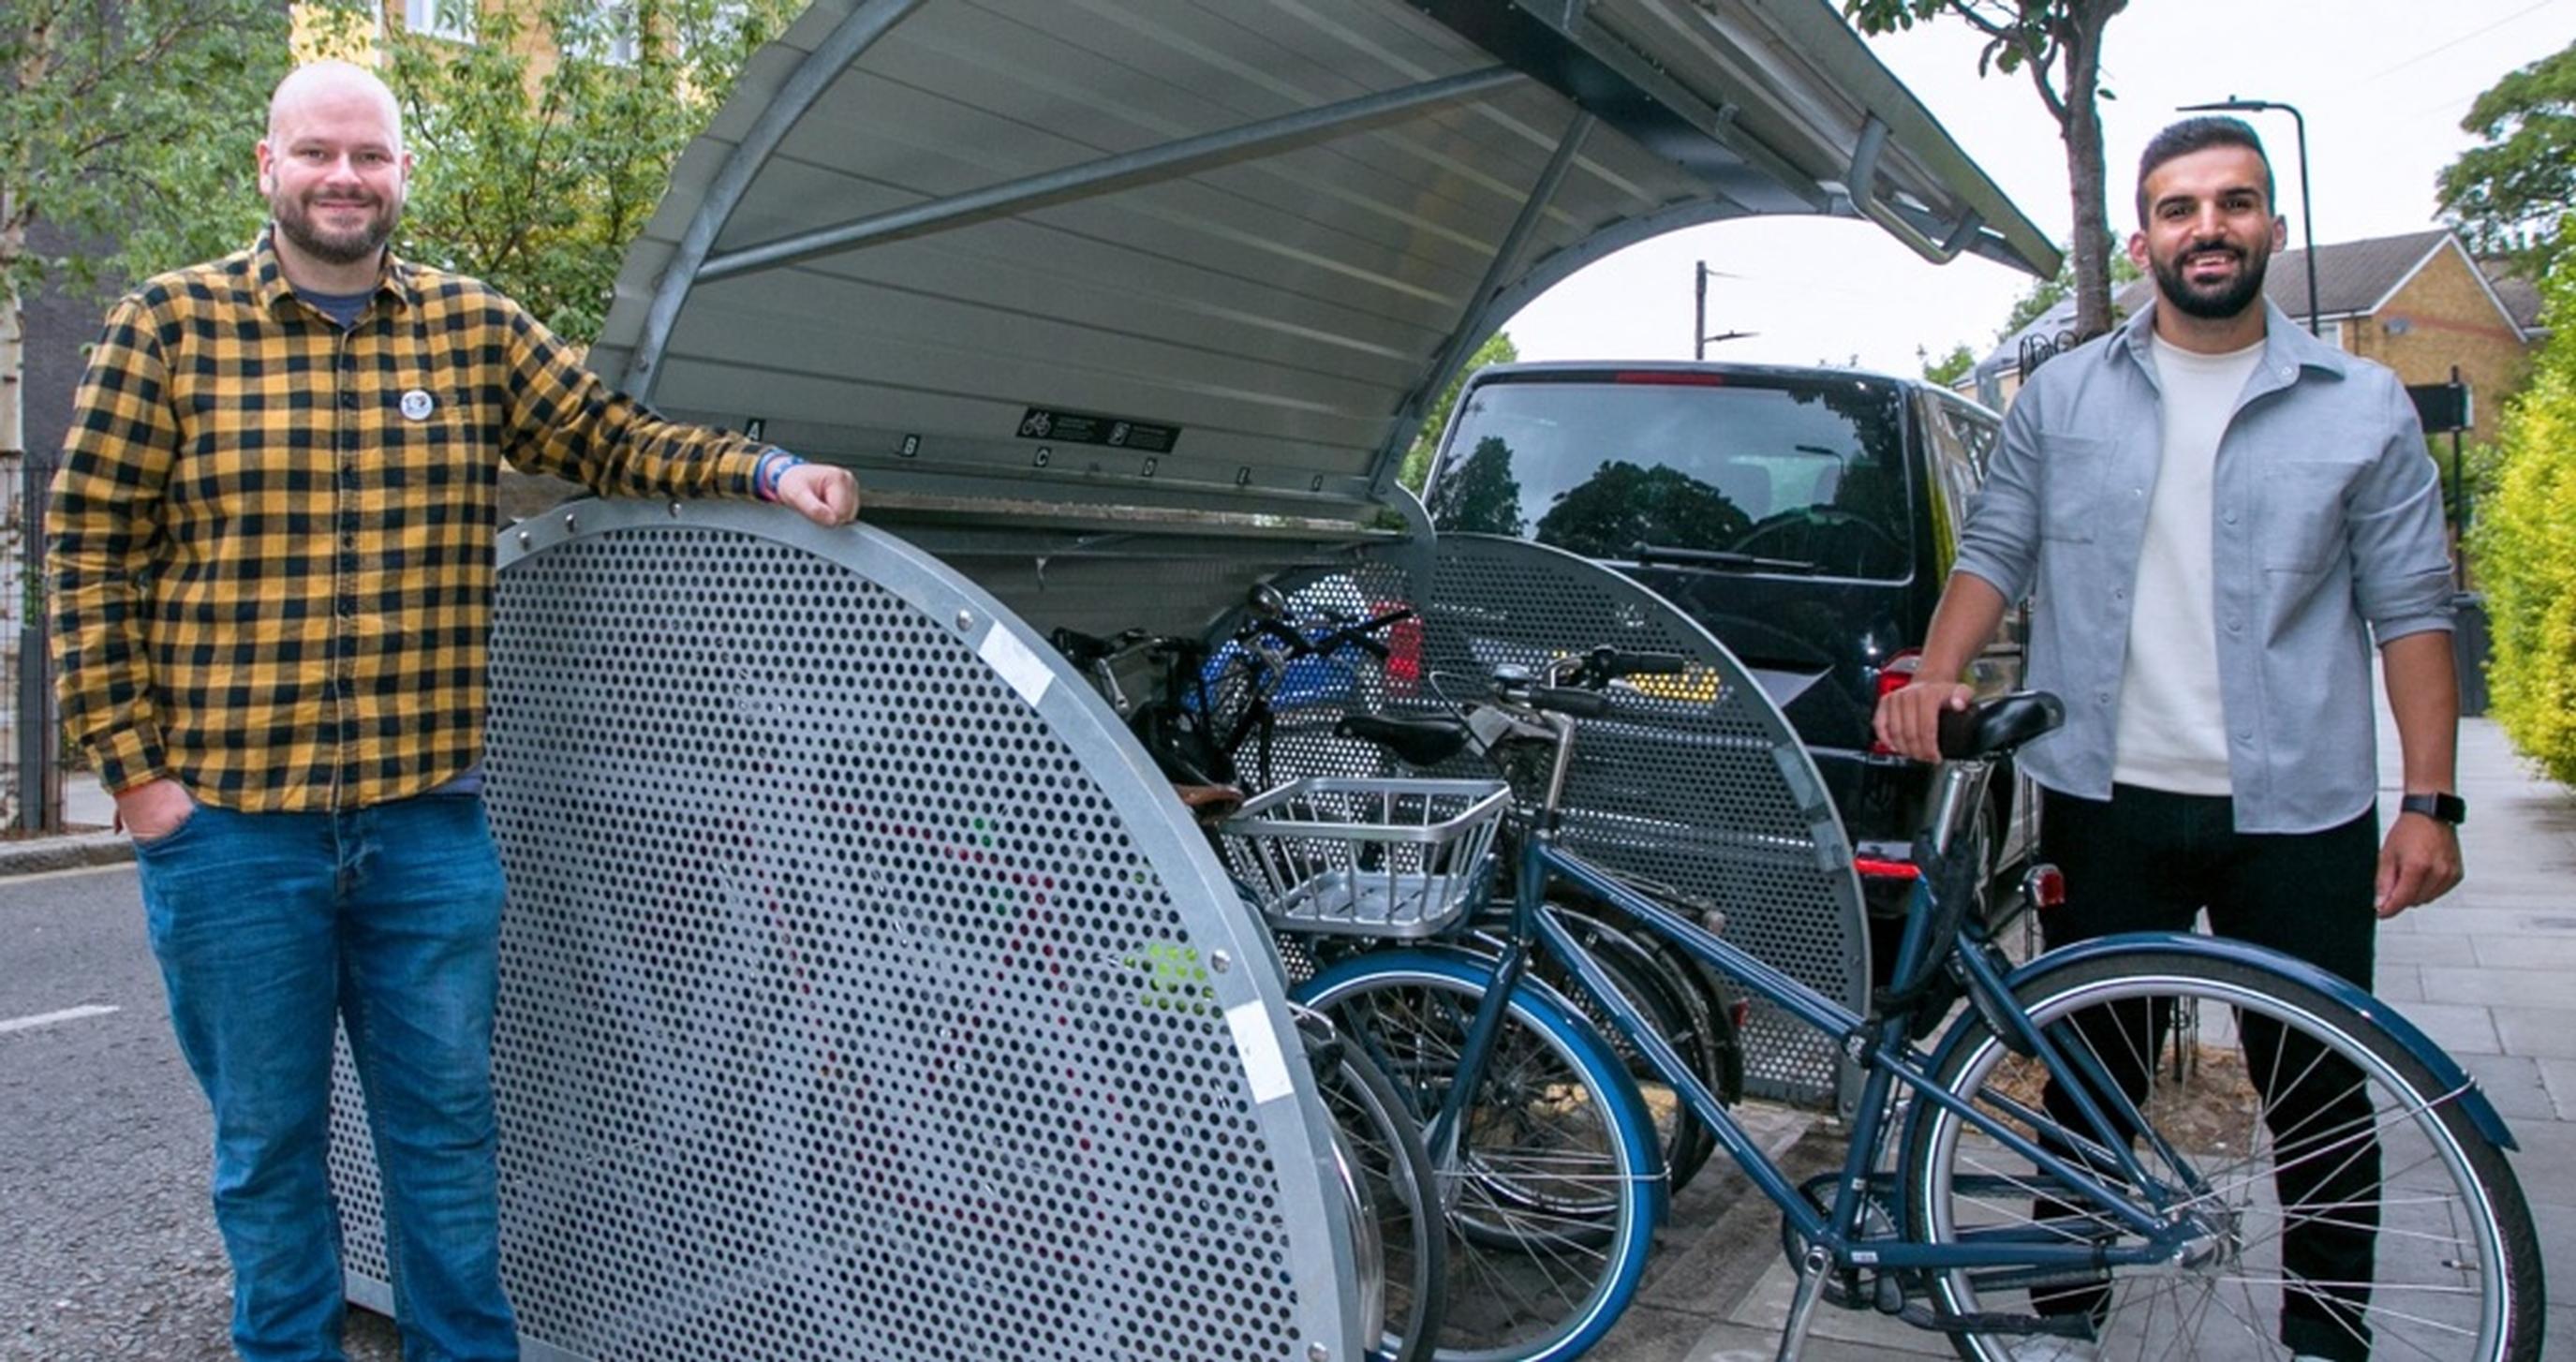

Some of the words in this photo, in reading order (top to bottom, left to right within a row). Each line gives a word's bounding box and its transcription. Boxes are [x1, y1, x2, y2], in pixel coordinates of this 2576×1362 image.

[747, 422, 760, 440] A
[905, 437, 917, 454] B
[1036, 449, 1049, 465] C
